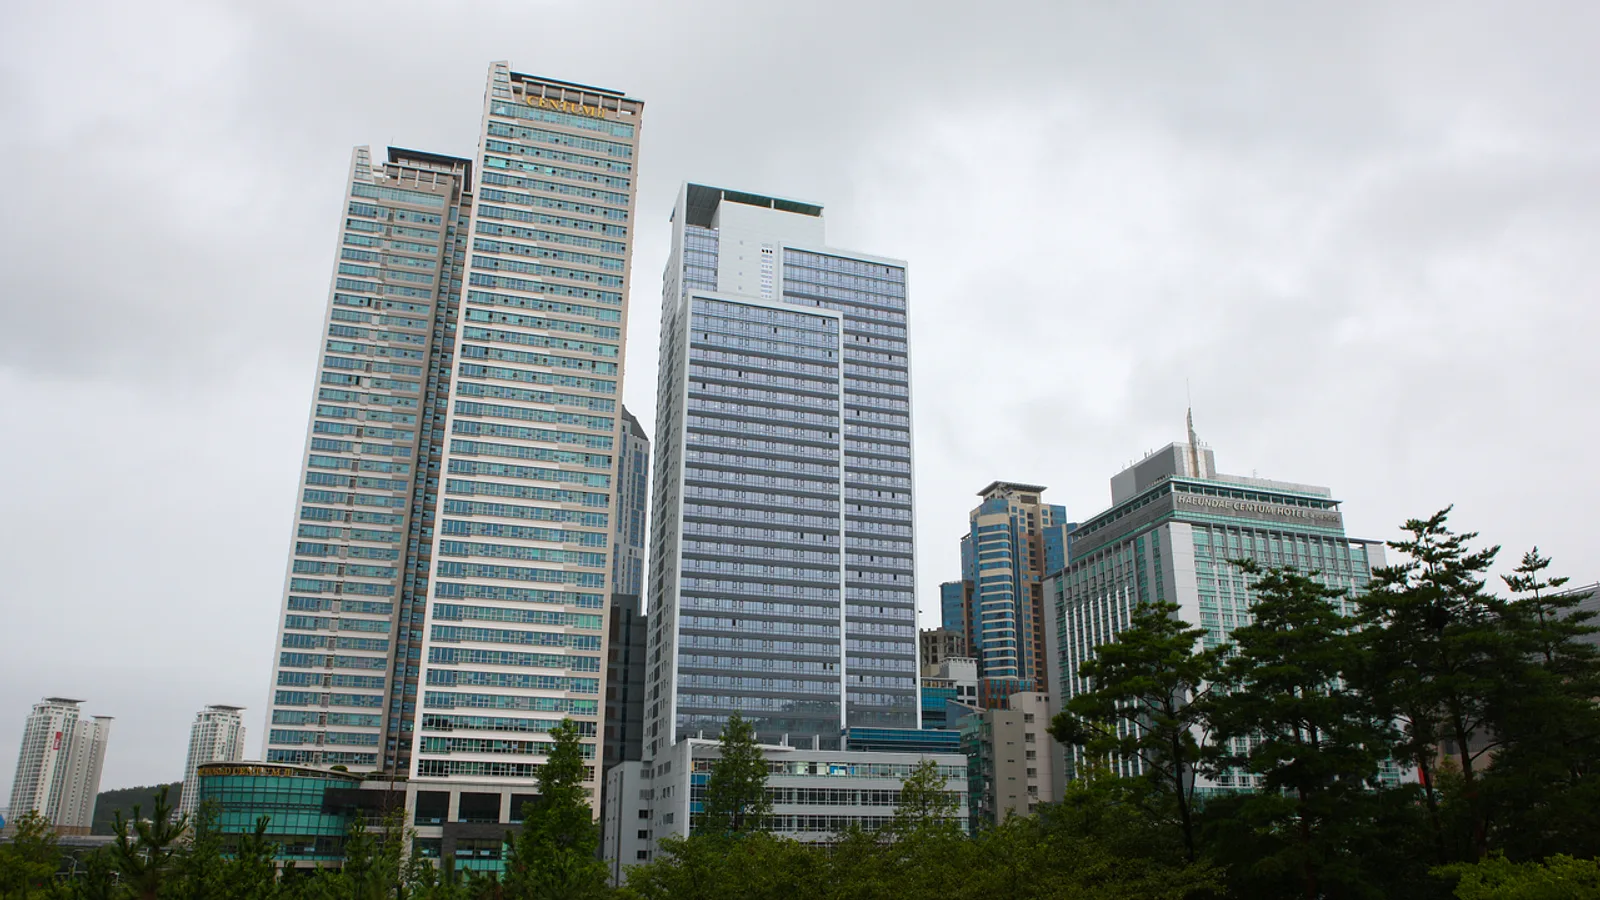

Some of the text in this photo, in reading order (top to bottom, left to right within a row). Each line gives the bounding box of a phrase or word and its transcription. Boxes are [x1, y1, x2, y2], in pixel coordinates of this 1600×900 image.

[526, 95, 595, 117] CENTUM
[1178, 495, 1230, 509] HAEUNDAE
[1233, 501, 1274, 514] CENTUM
[1277, 507, 1306, 518] HOTEL
